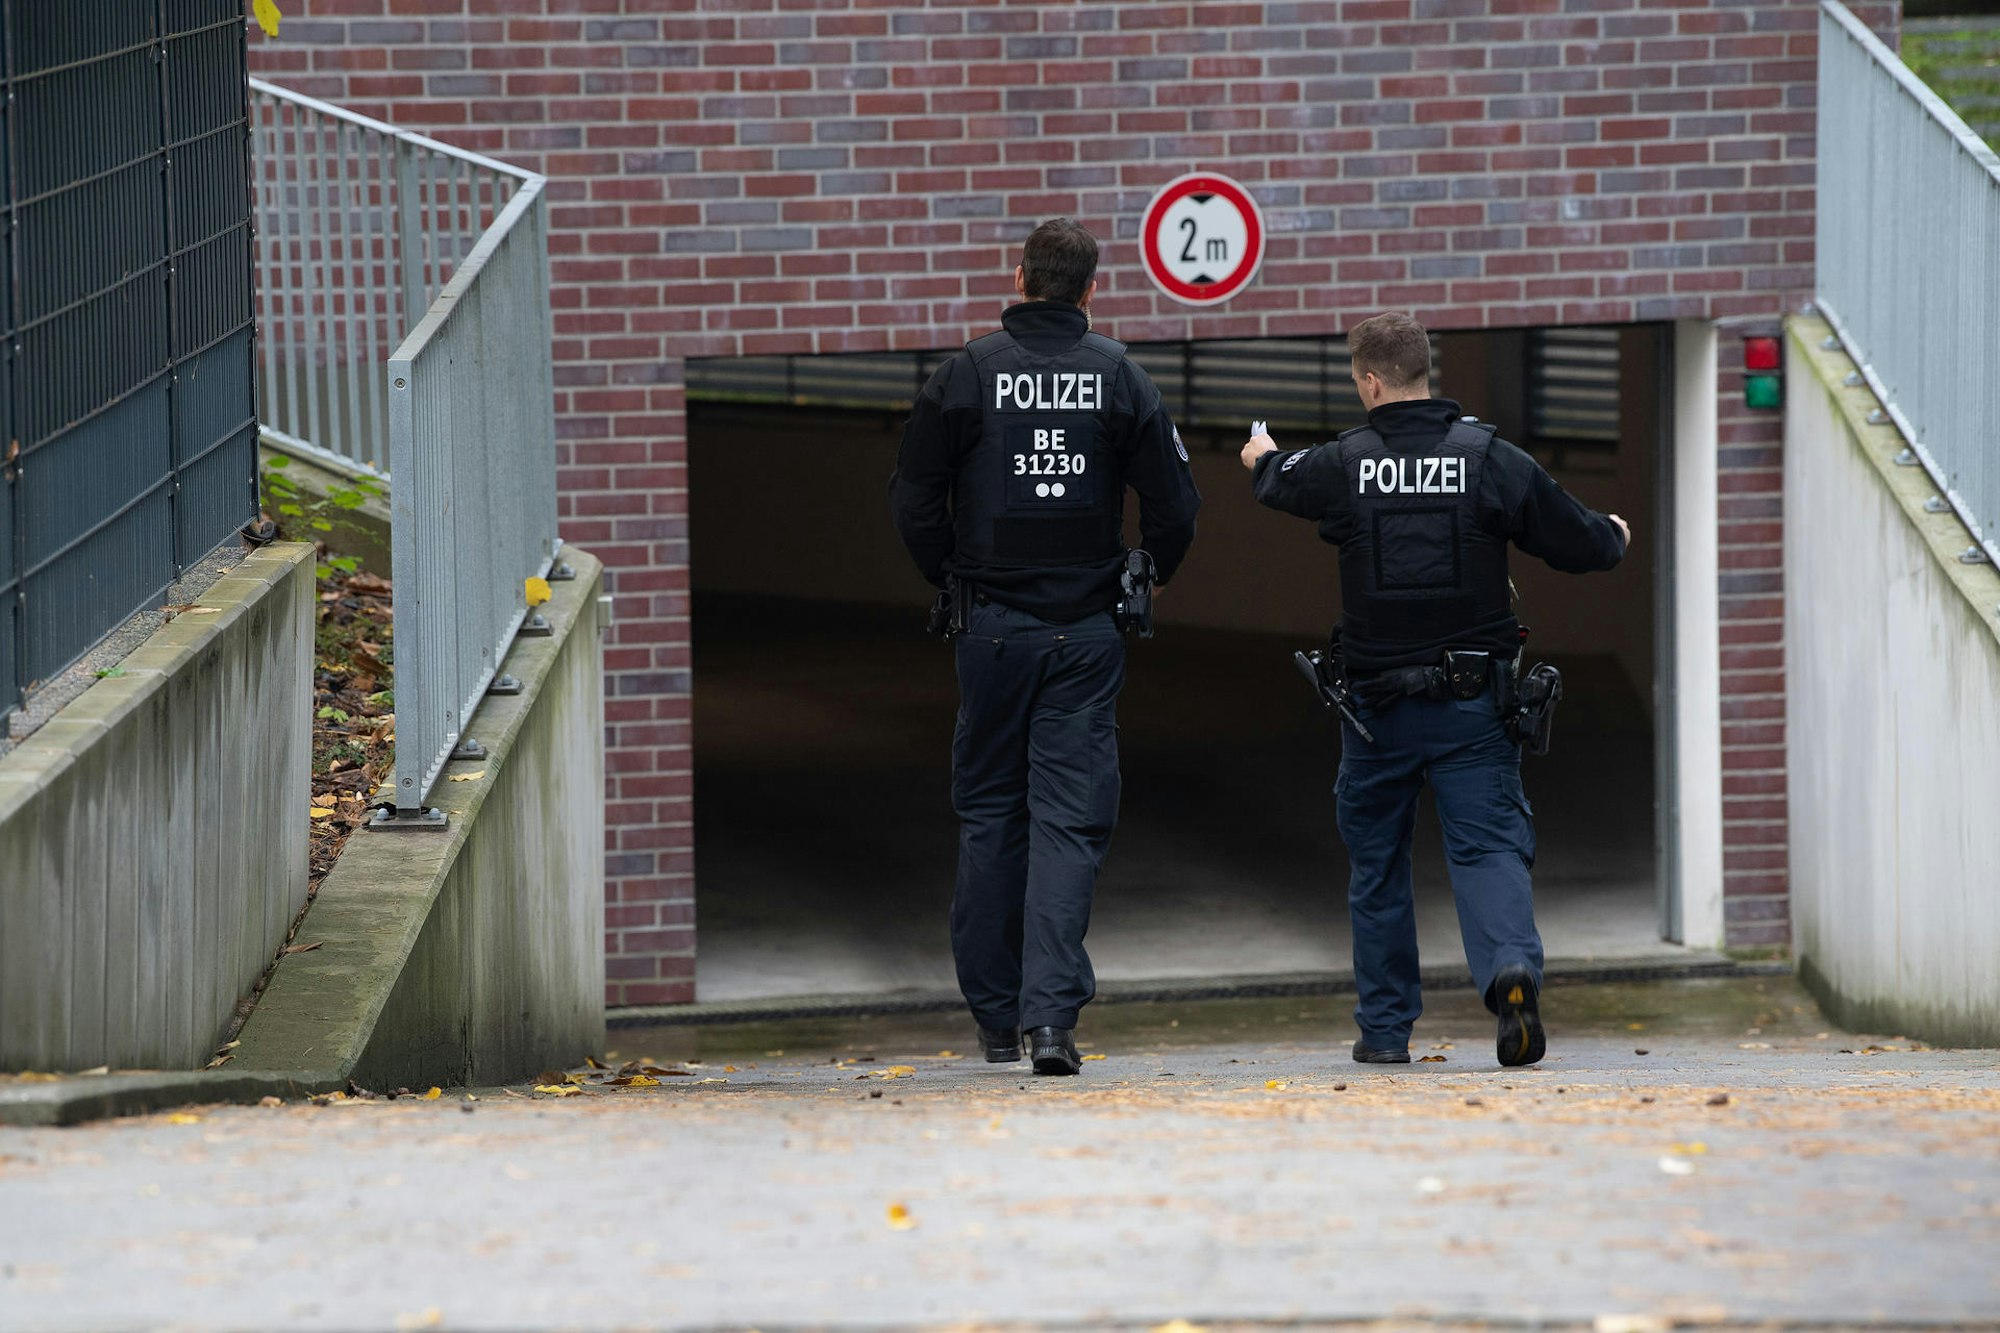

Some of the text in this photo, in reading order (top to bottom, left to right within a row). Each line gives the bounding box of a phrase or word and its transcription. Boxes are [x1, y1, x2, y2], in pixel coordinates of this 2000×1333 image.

[1180, 217, 1228, 262] 2 m
[996, 373, 1102, 410] POLIZEI
[1034, 429, 1066, 451] BE
[1013, 453, 1086, 475] 31230
[1358, 457, 1466, 494] POLIZEI
